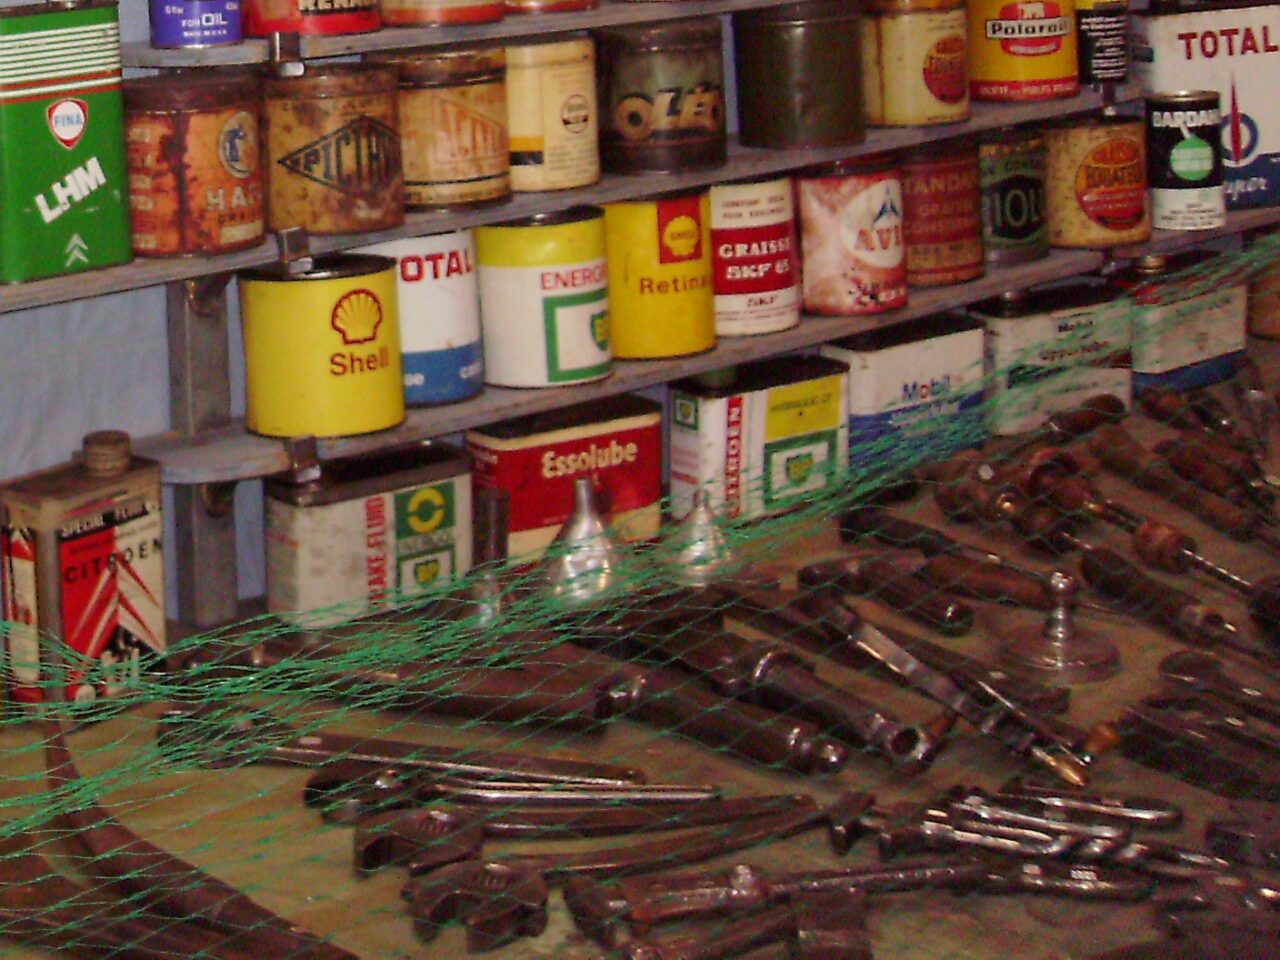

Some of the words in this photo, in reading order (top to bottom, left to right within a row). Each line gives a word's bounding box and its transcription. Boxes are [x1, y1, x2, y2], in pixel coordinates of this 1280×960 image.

[201, 13, 229, 27] OIL
[1176, 25, 1280, 60] TOTAL
[54, 112, 83, 127] FINA
[35, 156, 108, 224] LHM
[397, 247, 476, 282] OTAL
[329, 349, 390, 377] Shell
[541, 440, 637, 479] Essolube
